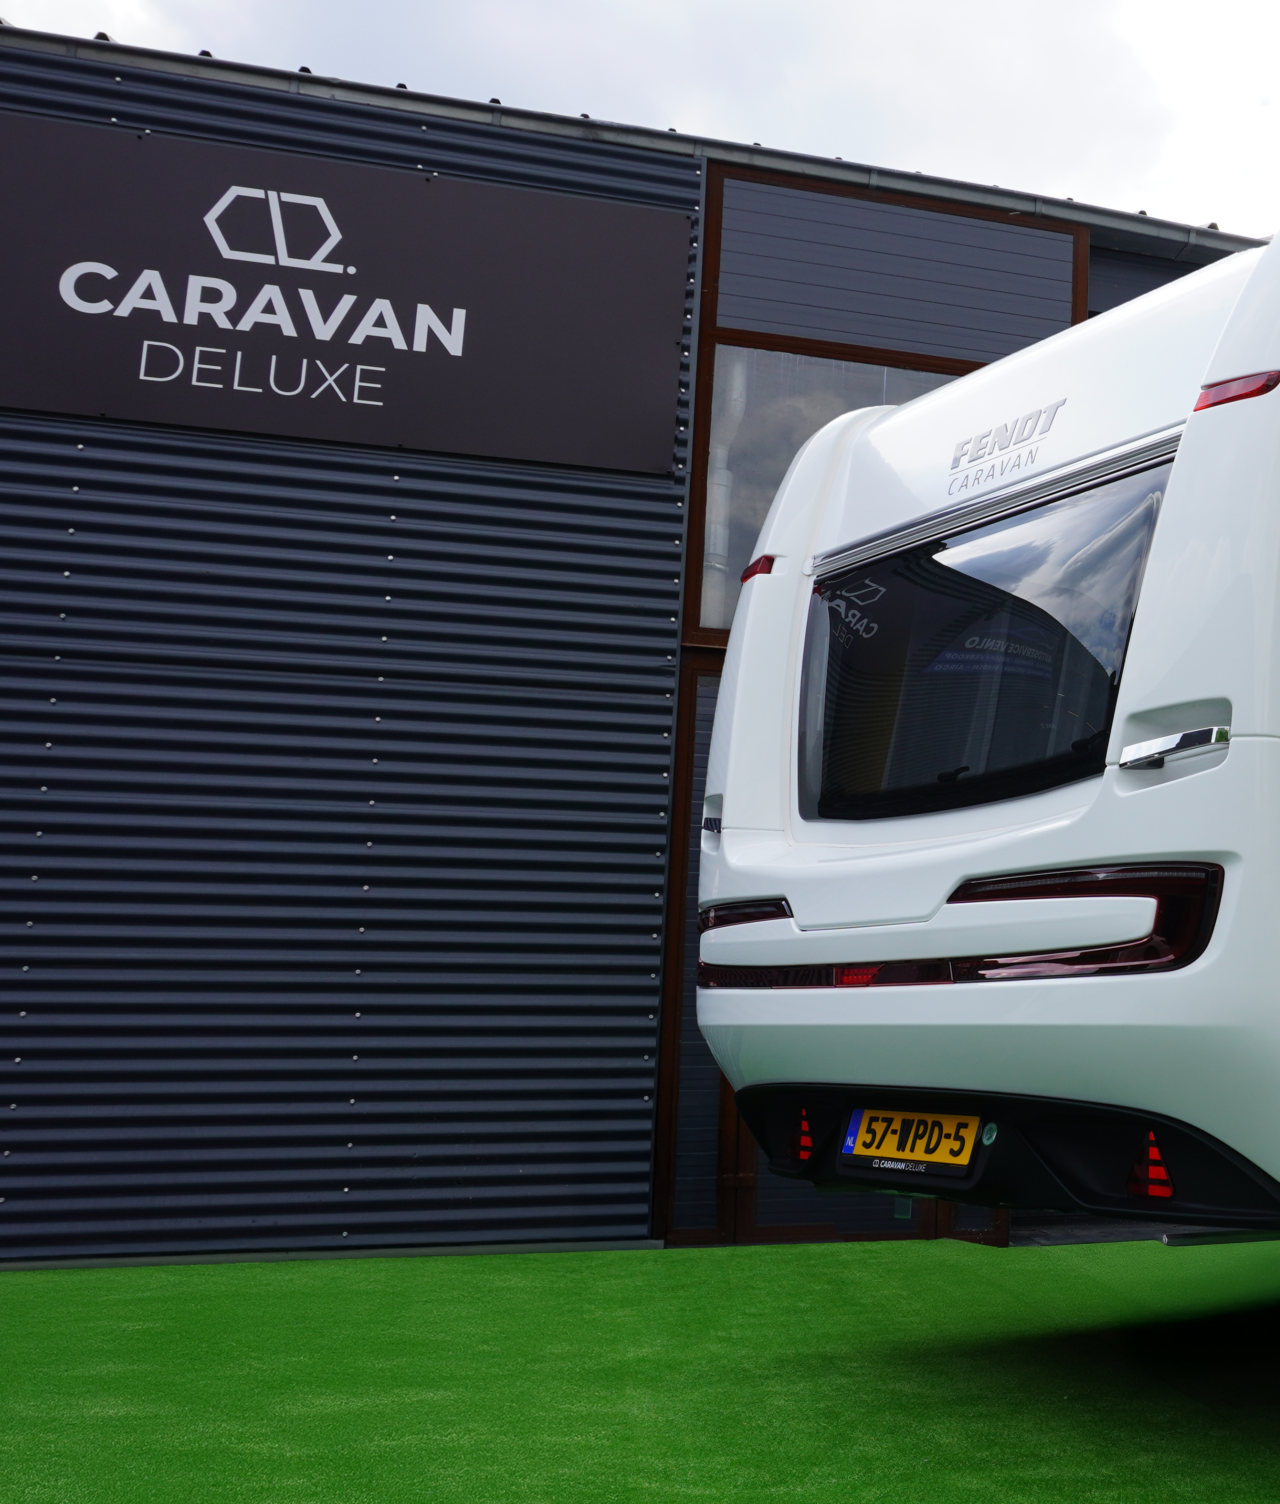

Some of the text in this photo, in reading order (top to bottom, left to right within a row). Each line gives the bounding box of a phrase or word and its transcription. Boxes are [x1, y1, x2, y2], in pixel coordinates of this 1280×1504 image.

[58, 260, 467, 357] CARAVAN
[138, 339, 386, 406] DELUXE
[949, 397, 1068, 471] FENDT
[947, 446, 1040, 496] CARAVAN
[846, 1136, 855, 1147] NL
[861, 1115, 969, 1158] 57-WPD-5
